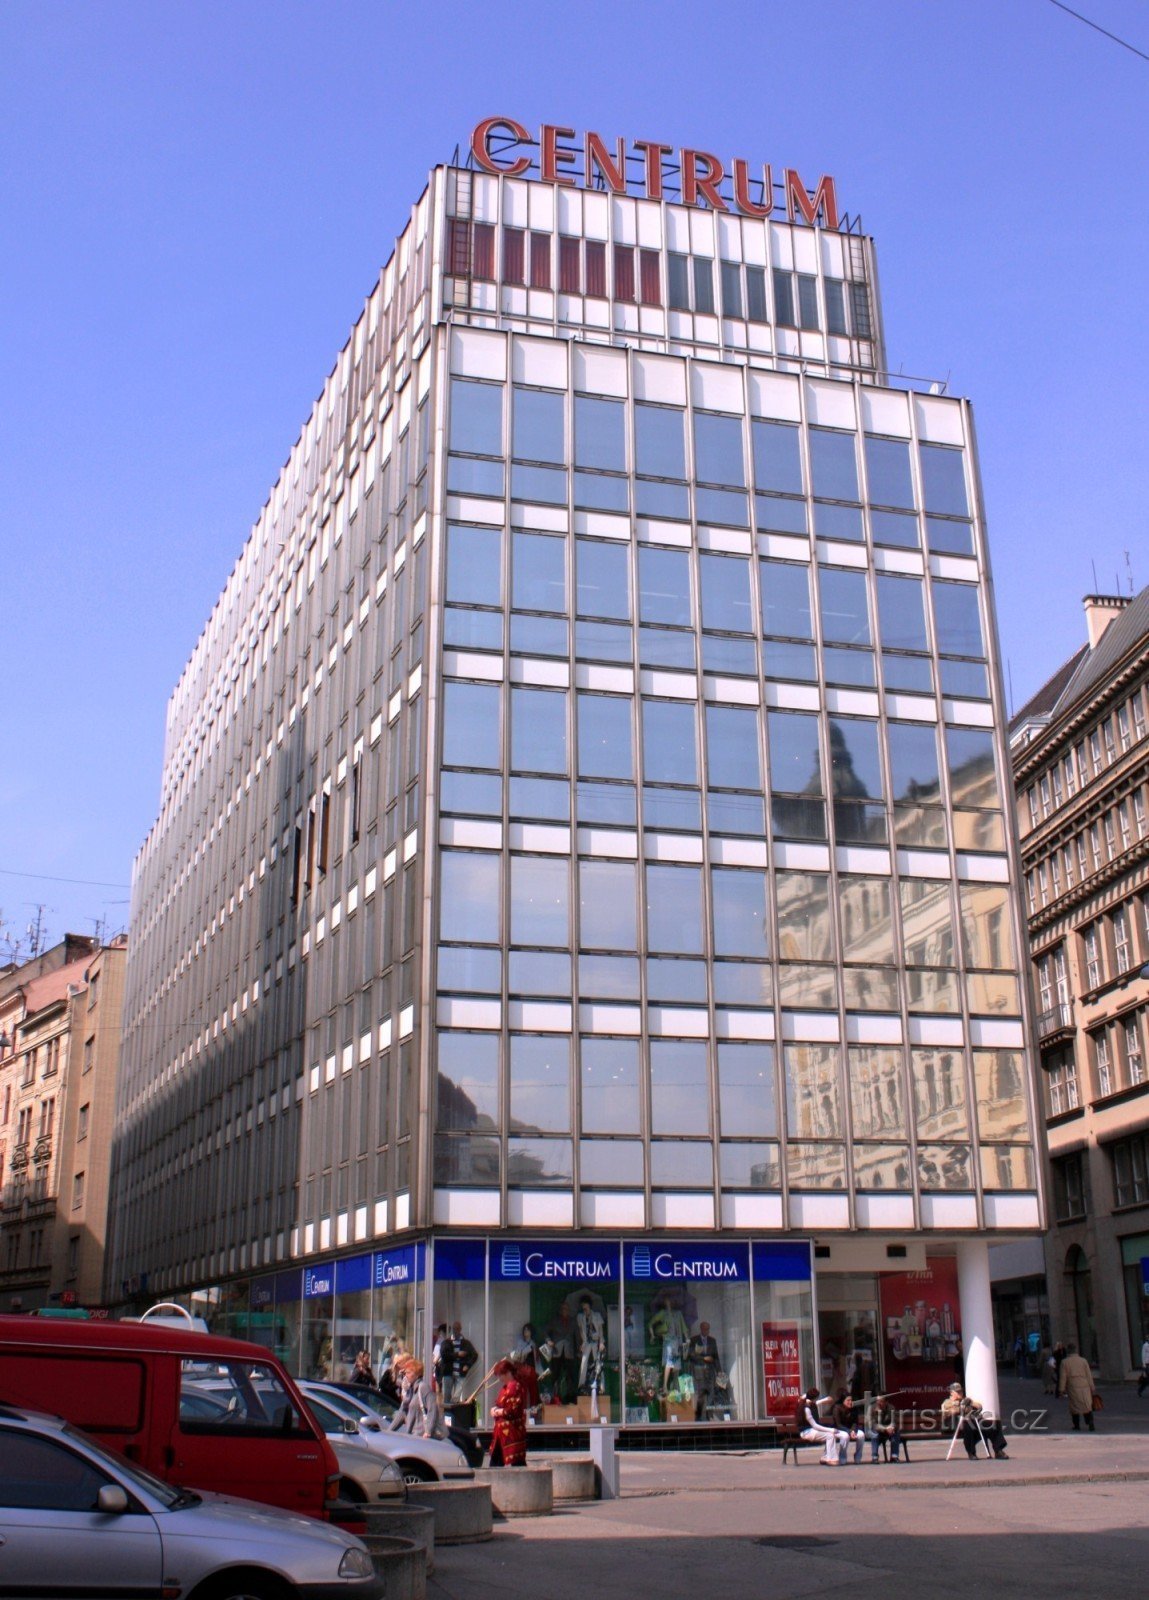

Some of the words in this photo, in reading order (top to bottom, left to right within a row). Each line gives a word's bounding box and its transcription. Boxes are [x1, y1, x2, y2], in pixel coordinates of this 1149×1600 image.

[470, 116, 840, 229] CENTRUM
[383, 1260, 408, 1283] CENTRUM
[525, 1253, 611, 1278] CENTRUM
[654, 1253, 739, 1278] CENTRUM
[781, 1340, 797, 1357] 10%
[768, 1379, 784, 1398] 10%
[899, 1385, 951, 1394] www.fann.c
